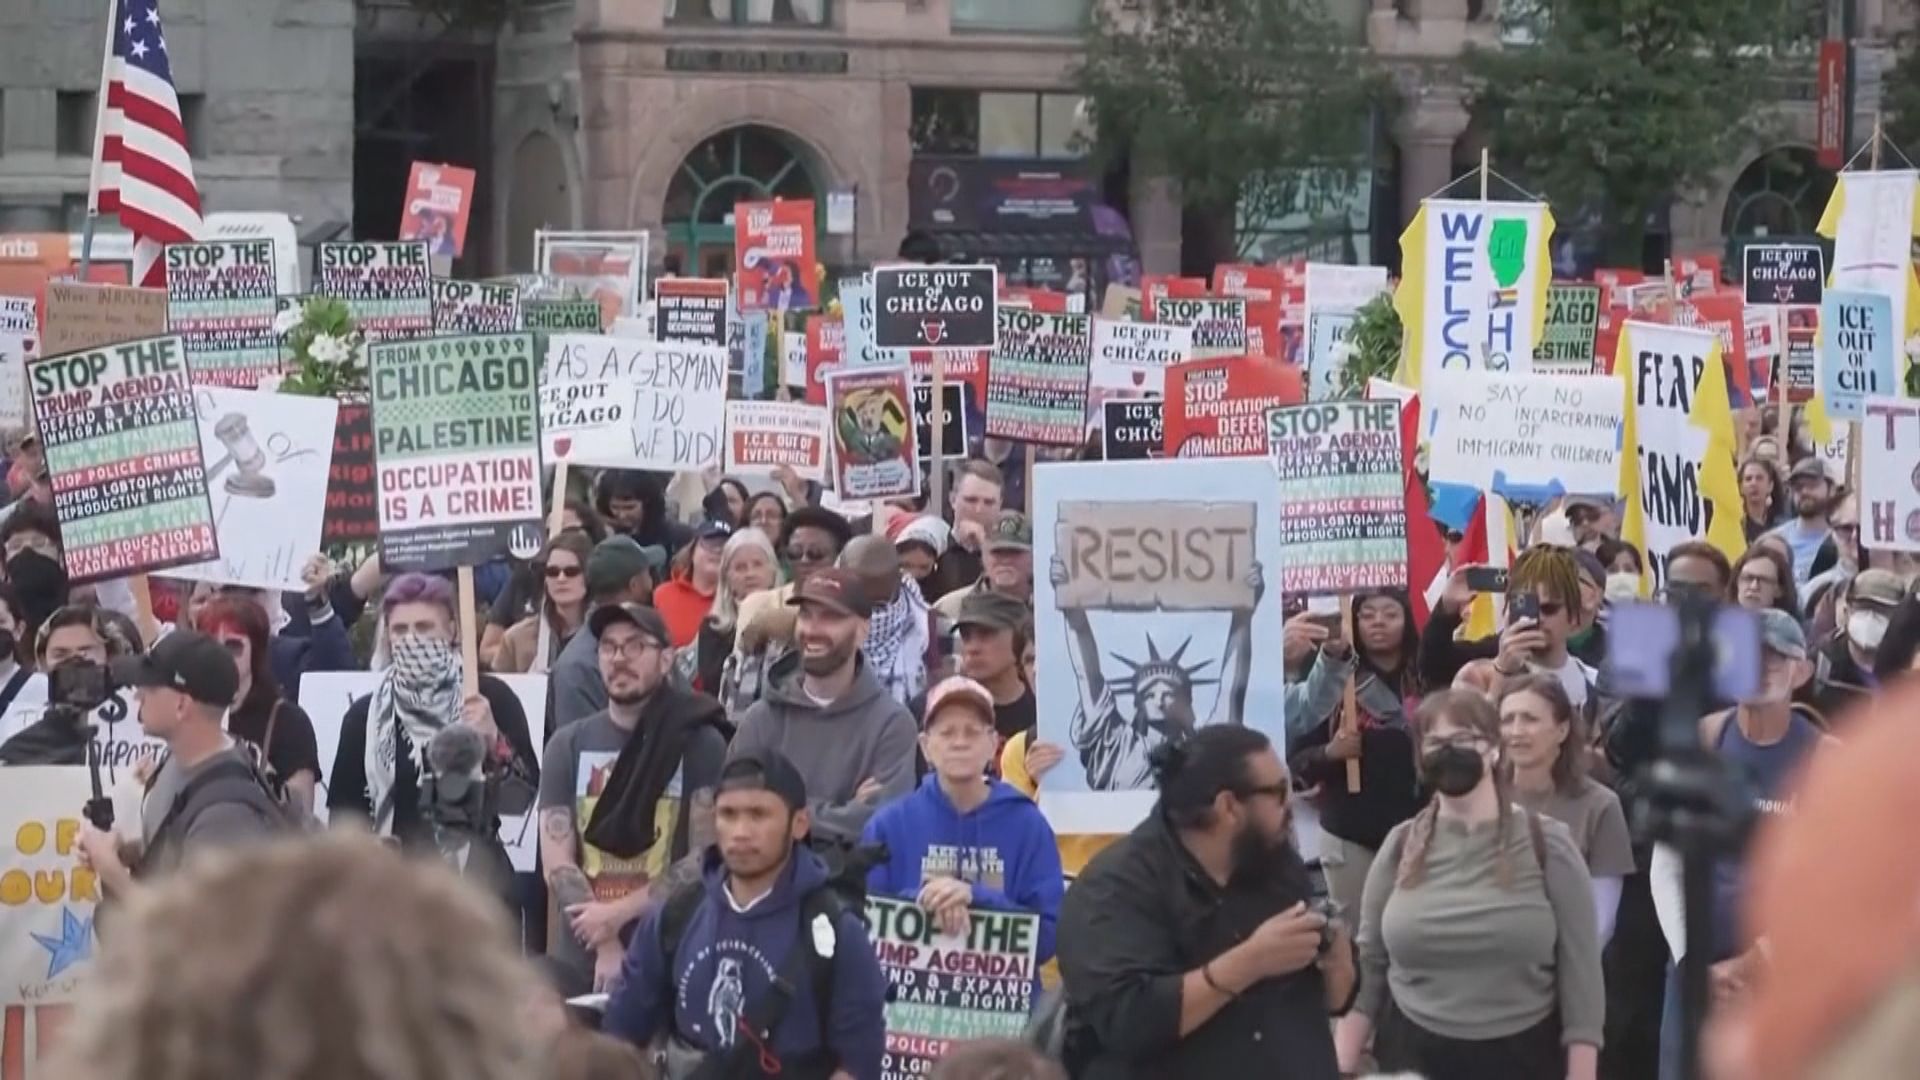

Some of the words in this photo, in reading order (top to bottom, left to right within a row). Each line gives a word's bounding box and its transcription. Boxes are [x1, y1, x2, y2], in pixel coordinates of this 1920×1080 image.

[168, 246, 225, 267] STOP
[231, 243, 270, 265] THE
[323, 246, 377, 266] STOP
[382, 243, 425, 265] THE
[1761, 250, 1782, 263] ICE
[1785, 250, 1809, 263] OUT
[168, 268, 211, 281] TRUMP
[216, 265, 272, 279] AGENDA!
[324, 268, 364, 280] TRUMP
[369, 267, 427, 280] AGENDA!
[898, 272, 929, 288] ICE
[934, 271, 971, 288] OUT
[1752, 267, 1816, 280] CHICAGO
[437, 282, 473, 302] TOP
[480, 286, 514, 306] THE
[925, 286, 943, 299] OF
[886, 296, 984, 313] CHICAGO
[1159, 302, 1203, 319] STOP
[1209, 302, 1242, 319] THE
[200, 317, 236, 329] POLICE
[525, 311, 598, 328] CHICAGO
[999, 311, 1044, 333] STOP
[1051, 316, 1087, 336] THE
[1838, 304, 1874, 331] ICE
[1112, 325, 1138, 340] ICE
[1142, 327, 1172, 342] OUT
[1837, 330, 1876, 351] OUT
[184, 338, 241, 351] RODUCTIVE
[1103, 345, 1182, 364] CHICAGO
[1533, 341, 1591, 360] ESTINE
[376, 348, 421, 365] FROM
[33, 353, 108, 396] STOP
[116, 339, 180, 377] THE
[555, 344, 588, 379] AS
[599, 346, 619, 379] A
[628, 351, 724, 392] GERMAN
[375, 356, 530, 401] CHICAGO
[37, 388, 93, 419] TRUMP
[101, 371, 185, 404] AGENDA!
[567, 383, 609, 400] OUT
[1184, 381, 1228, 401] STOP
[1487, 384, 1528, 402] SAY
[1555, 387, 1583, 408] NO
[40, 408, 96, 434] DEFEND
[124, 391, 193, 416] EXPAND
[509, 394, 531, 412] TO
[652, 392, 685, 426] DO
[1125, 405, 1153, 419] ICE
[1185, 396, 1280, 418] DEPORTATIONS
[548, 404, 622, 428] ICAGO
[1218, 416, 1265, 436] DEFEN
[1270, 405, 1339, 437] STOP
[1347, 404, 1395, 431] THE
[1459, 404, 1487, 423] NO
[1514, 407, 1619, 430] INCARCERATION
[43, 419, 124, 448] IMMIGRANT
[134, 407, 195, 427] RIGHTS
[378, 416, 533, 455] PALESTINE
[1115, 427, 1162, 442] CHIC
[1518, 423, 1541, 439] OF
[631, 426, 665, 461] WE
[744, 433, 774, 447] I.C.E.
[777, 434, 799, 448] OUT
[800, 435, 813, 450] OF
[1184, 436, 1263, 456] IMMIGRAN
[1270, 435, 1322, 455] TRUMP
[1329, 432, 1398, 449] AGENDA!
[1457, 437, 1542, 459] IMMIGRANT
[1550, 444, 1613, 465] CHILDREN
[743, 447, 811, 466] EVERYWHERE
[1280, 451, 1322, 469] EFEND
[1349, 449, 1402, 463] EXPAND
[1356, 460, 1403, 473] RIGHTS
[52, 473, 83, 490] STOP
[88, 460, 137, 483] POLICE
[144, 449, 199, 470] CRIMES
[382, 458, 533, 491] OCCUPATION
[55, 487, 99, 507] DEFEND
[173, 467, 203, 483] AND
[57, 491, 149, 521] REPRODUCTIVE
[153, 482, 205, 501] RIGHTS
[385, 497, 407, 522] IS
[419, 494, 435, 518] A
[447, 486, 533, 515] CRIME!
[1309, 500, 1355, 513] POLICE
[1361, 499, 1404, 511] CRIMES
[1281, 517, 1317, 531] EFEND
[1383, 513, 1406, 525] AND
[1281, 526, 1360, 543] EPRODUCTIVE
[1366, 525, 1405, 537] RIGHTS
[65, 546, 109, 564] DEFEND
[114, 530, 195, 556] EDUCATION
[1071, 526, 1248, 582] RESIST
[68, 555, 135, 579] ACADEMIC
[142, 539, 214, 562] FREEDOM
[1284, 567, 1320, 580] EFEND
[1326, 564, 1395, 576] EDUCATION
[1285, 577, 1344, 592] CADEMIC
[1350, 574, 1408, 586] FREEDOM
[966, 914, 1032, 954] THE
[927, 949, 1031, 978] AGENDA!
[927, 973, 940, 989] &
[952, 976, 1033, 997] EXPAND
[959, 991, 1031, 1012] RIGHTS
